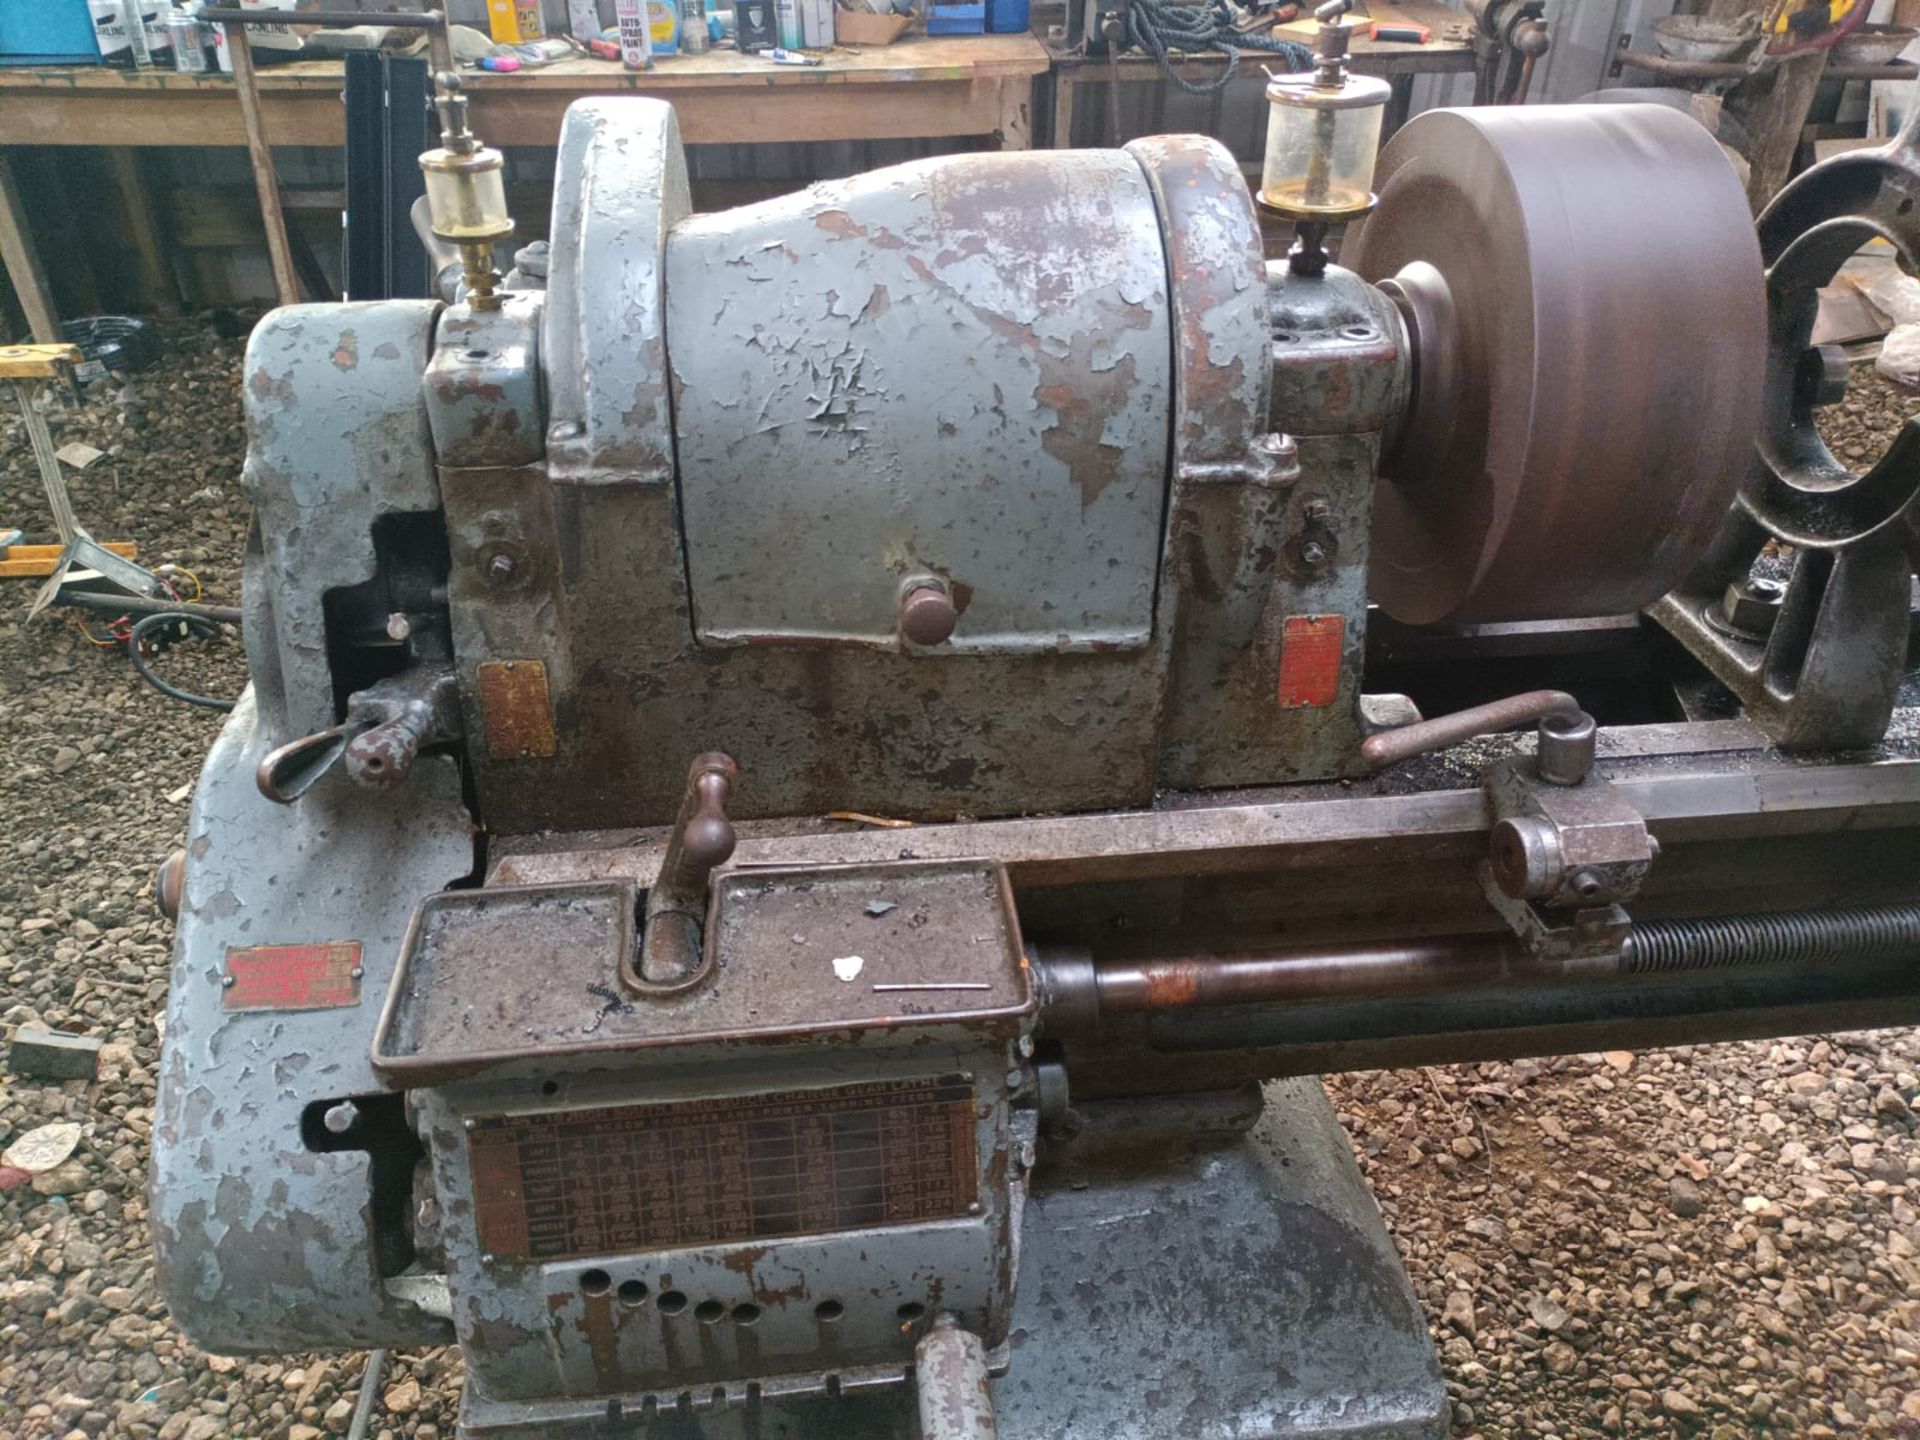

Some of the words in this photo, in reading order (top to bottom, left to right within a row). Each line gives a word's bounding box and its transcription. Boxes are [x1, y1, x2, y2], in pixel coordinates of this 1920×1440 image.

[623, 39, 643, 48] PAINT
[718, 1095, 768, 1108] QUICK
[773, 1088, 836, 1103] CHANGE
[845, 1084, 886, 1096] GEAR
[891, 1079, 938, 1092] LATHE
[727, 1109, 755, 1119] AND
[762, 1104, 812, 1116] POWER
[820, 1097, 883, 1111] TURNING
[890, 1092, 935, 1104] FEEDS
